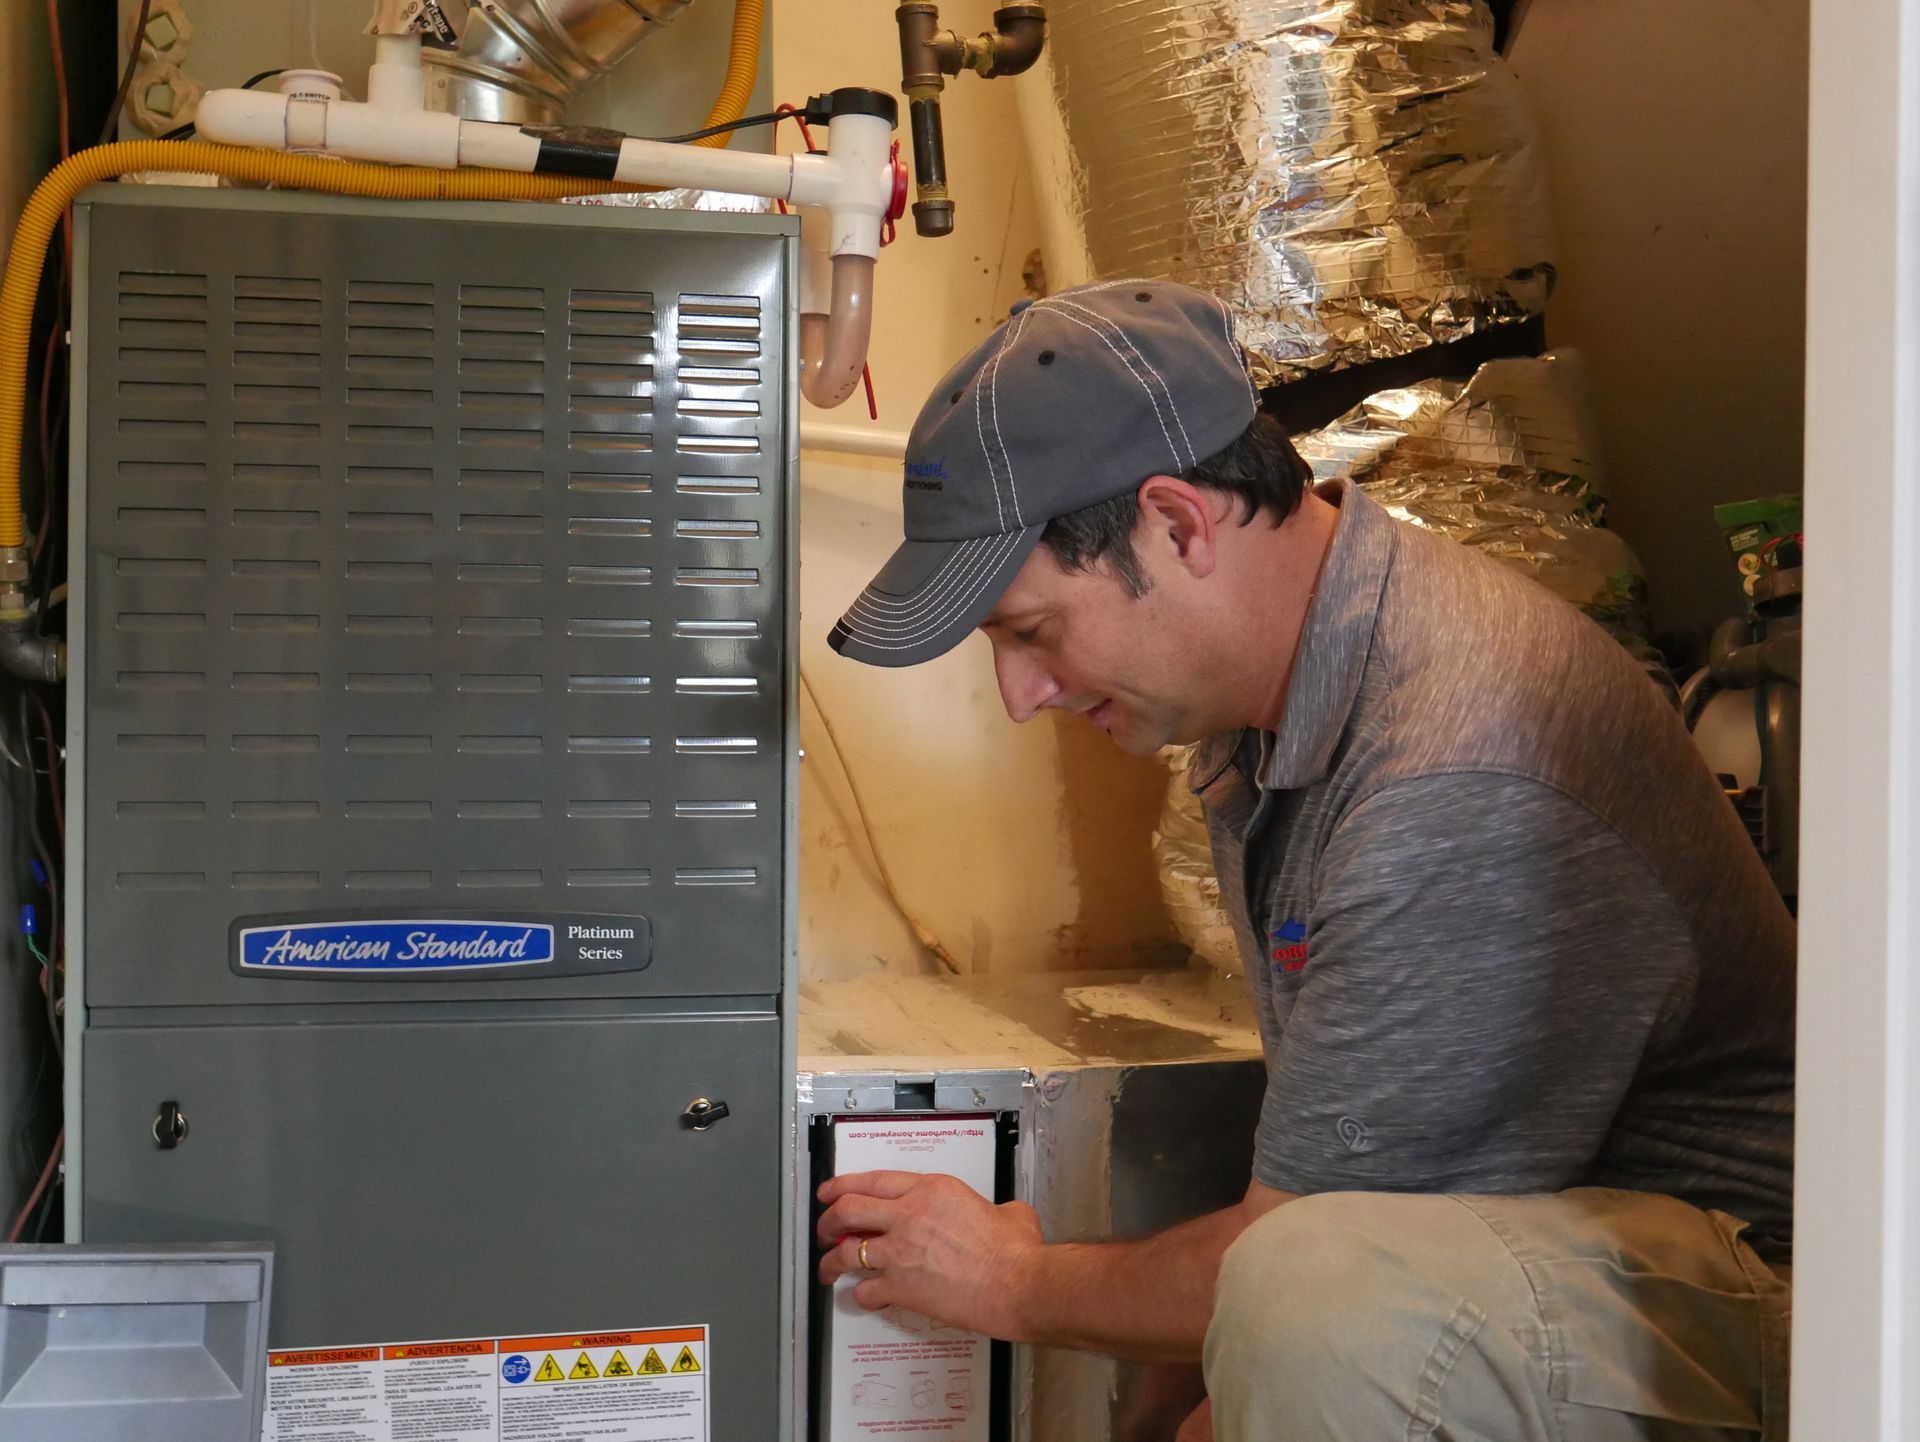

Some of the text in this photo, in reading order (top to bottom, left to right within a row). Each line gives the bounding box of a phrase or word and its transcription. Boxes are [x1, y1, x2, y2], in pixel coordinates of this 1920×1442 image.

[567, 925, 634, 939] Platinum
[262, 929, 533, 965] American Standard
[578, 946, 623, 960] Series
[582, 1334, 632, 1346] WARNING
[284, 1350, 375, 1364] AVERTISSEMENT
[406, 1343, 483, 1357] ADVERTENCIA
